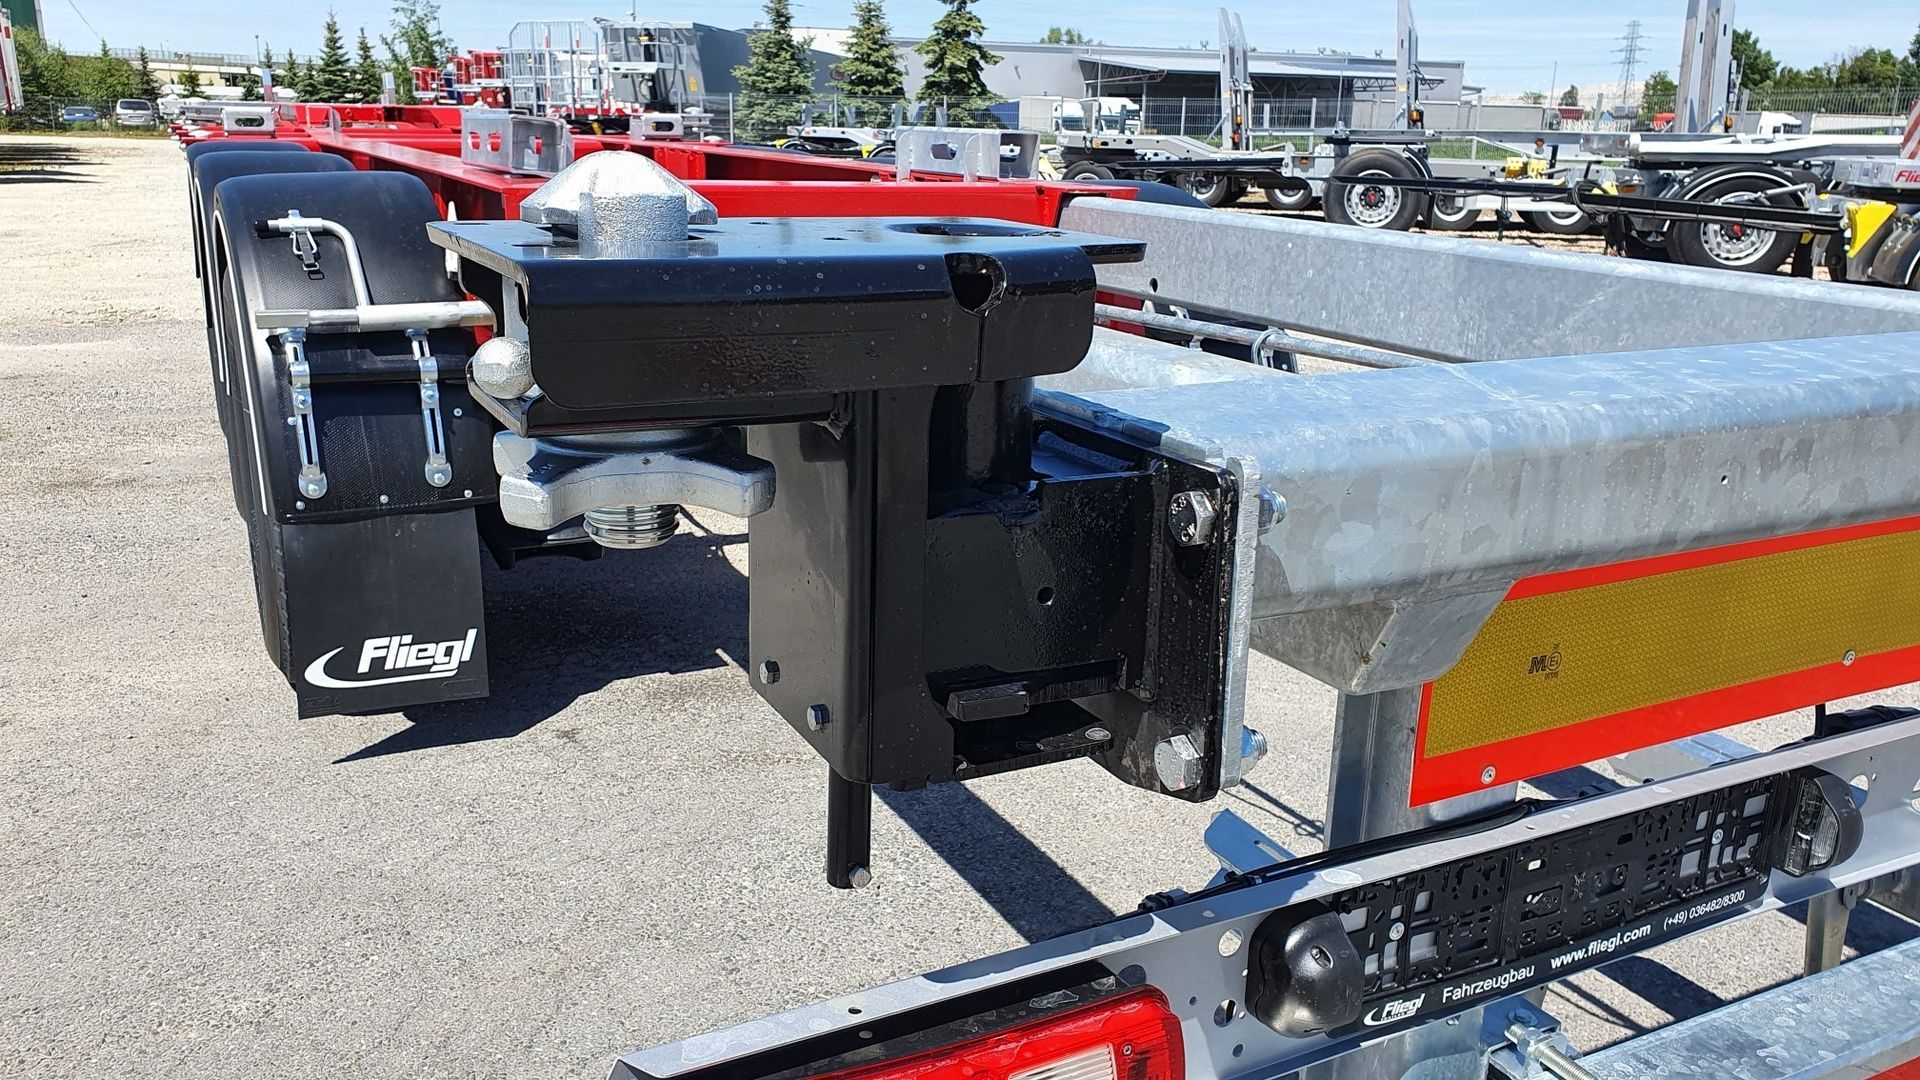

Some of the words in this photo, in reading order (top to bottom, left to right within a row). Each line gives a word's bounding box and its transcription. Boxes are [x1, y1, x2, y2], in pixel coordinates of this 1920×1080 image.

[357, 628, 478, 674] Fliegl
[1442, 965, 1535, 1004] Fahrzeugbau
[1550, 924, 1651, 970] www.fliegl.com
[1663, 909, 1689, 931] (+49)
[1689, 889, 1746, 920] 036482/8300
[1382, 993, 1426, 1018] Fliegl
